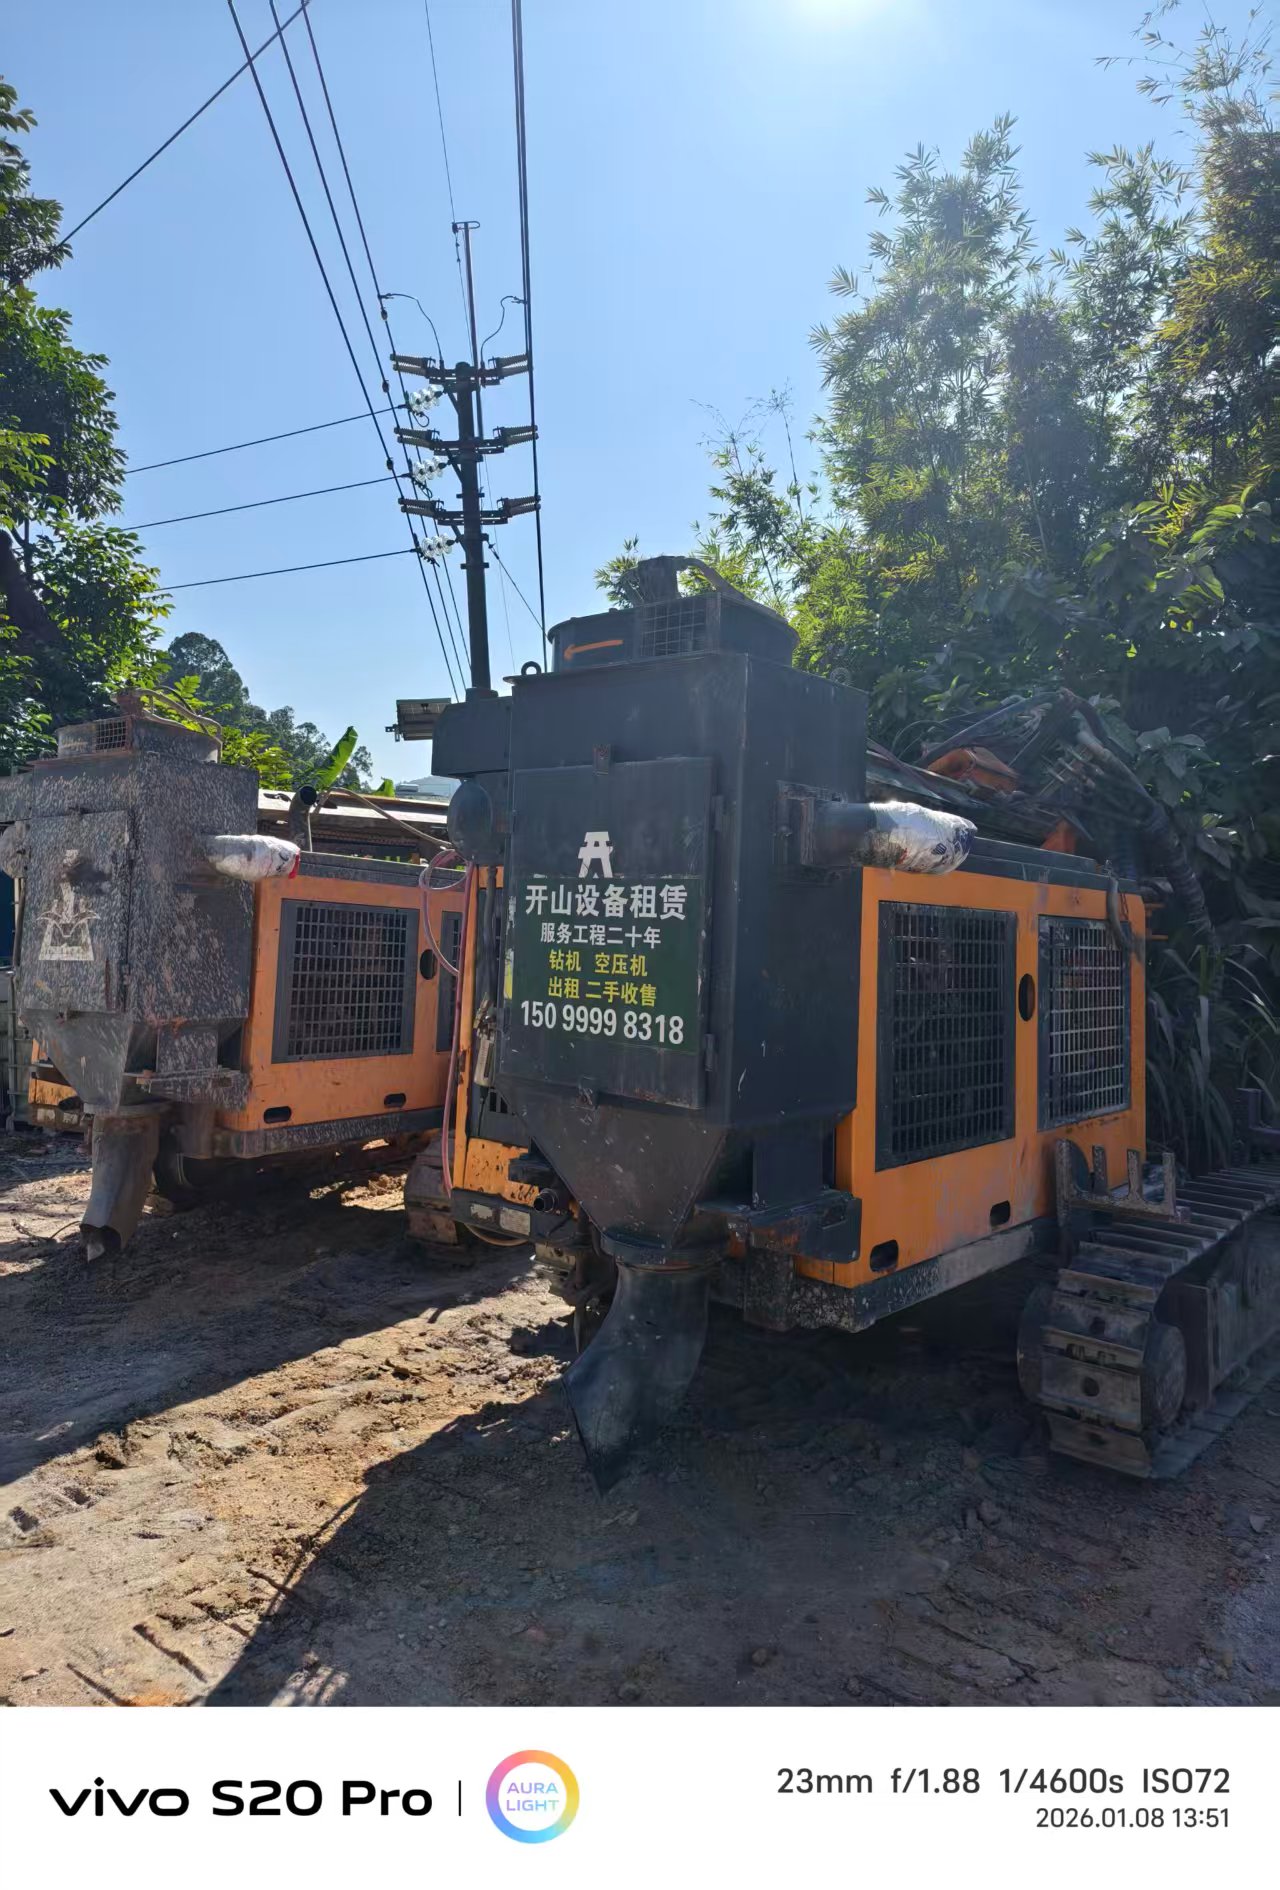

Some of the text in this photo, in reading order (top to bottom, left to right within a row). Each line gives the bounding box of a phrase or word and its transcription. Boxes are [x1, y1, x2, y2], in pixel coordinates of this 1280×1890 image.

[526, 884, 687, 920] 开山设备租赁
[541, 923, 661, 949] 服务工程二十年
[549, 949, 647, 976] 钻机 空压机
[549, 976, 656, 1007] 出租 二手收售
[521, 1001, 683, 1044] 150 9999 8318
